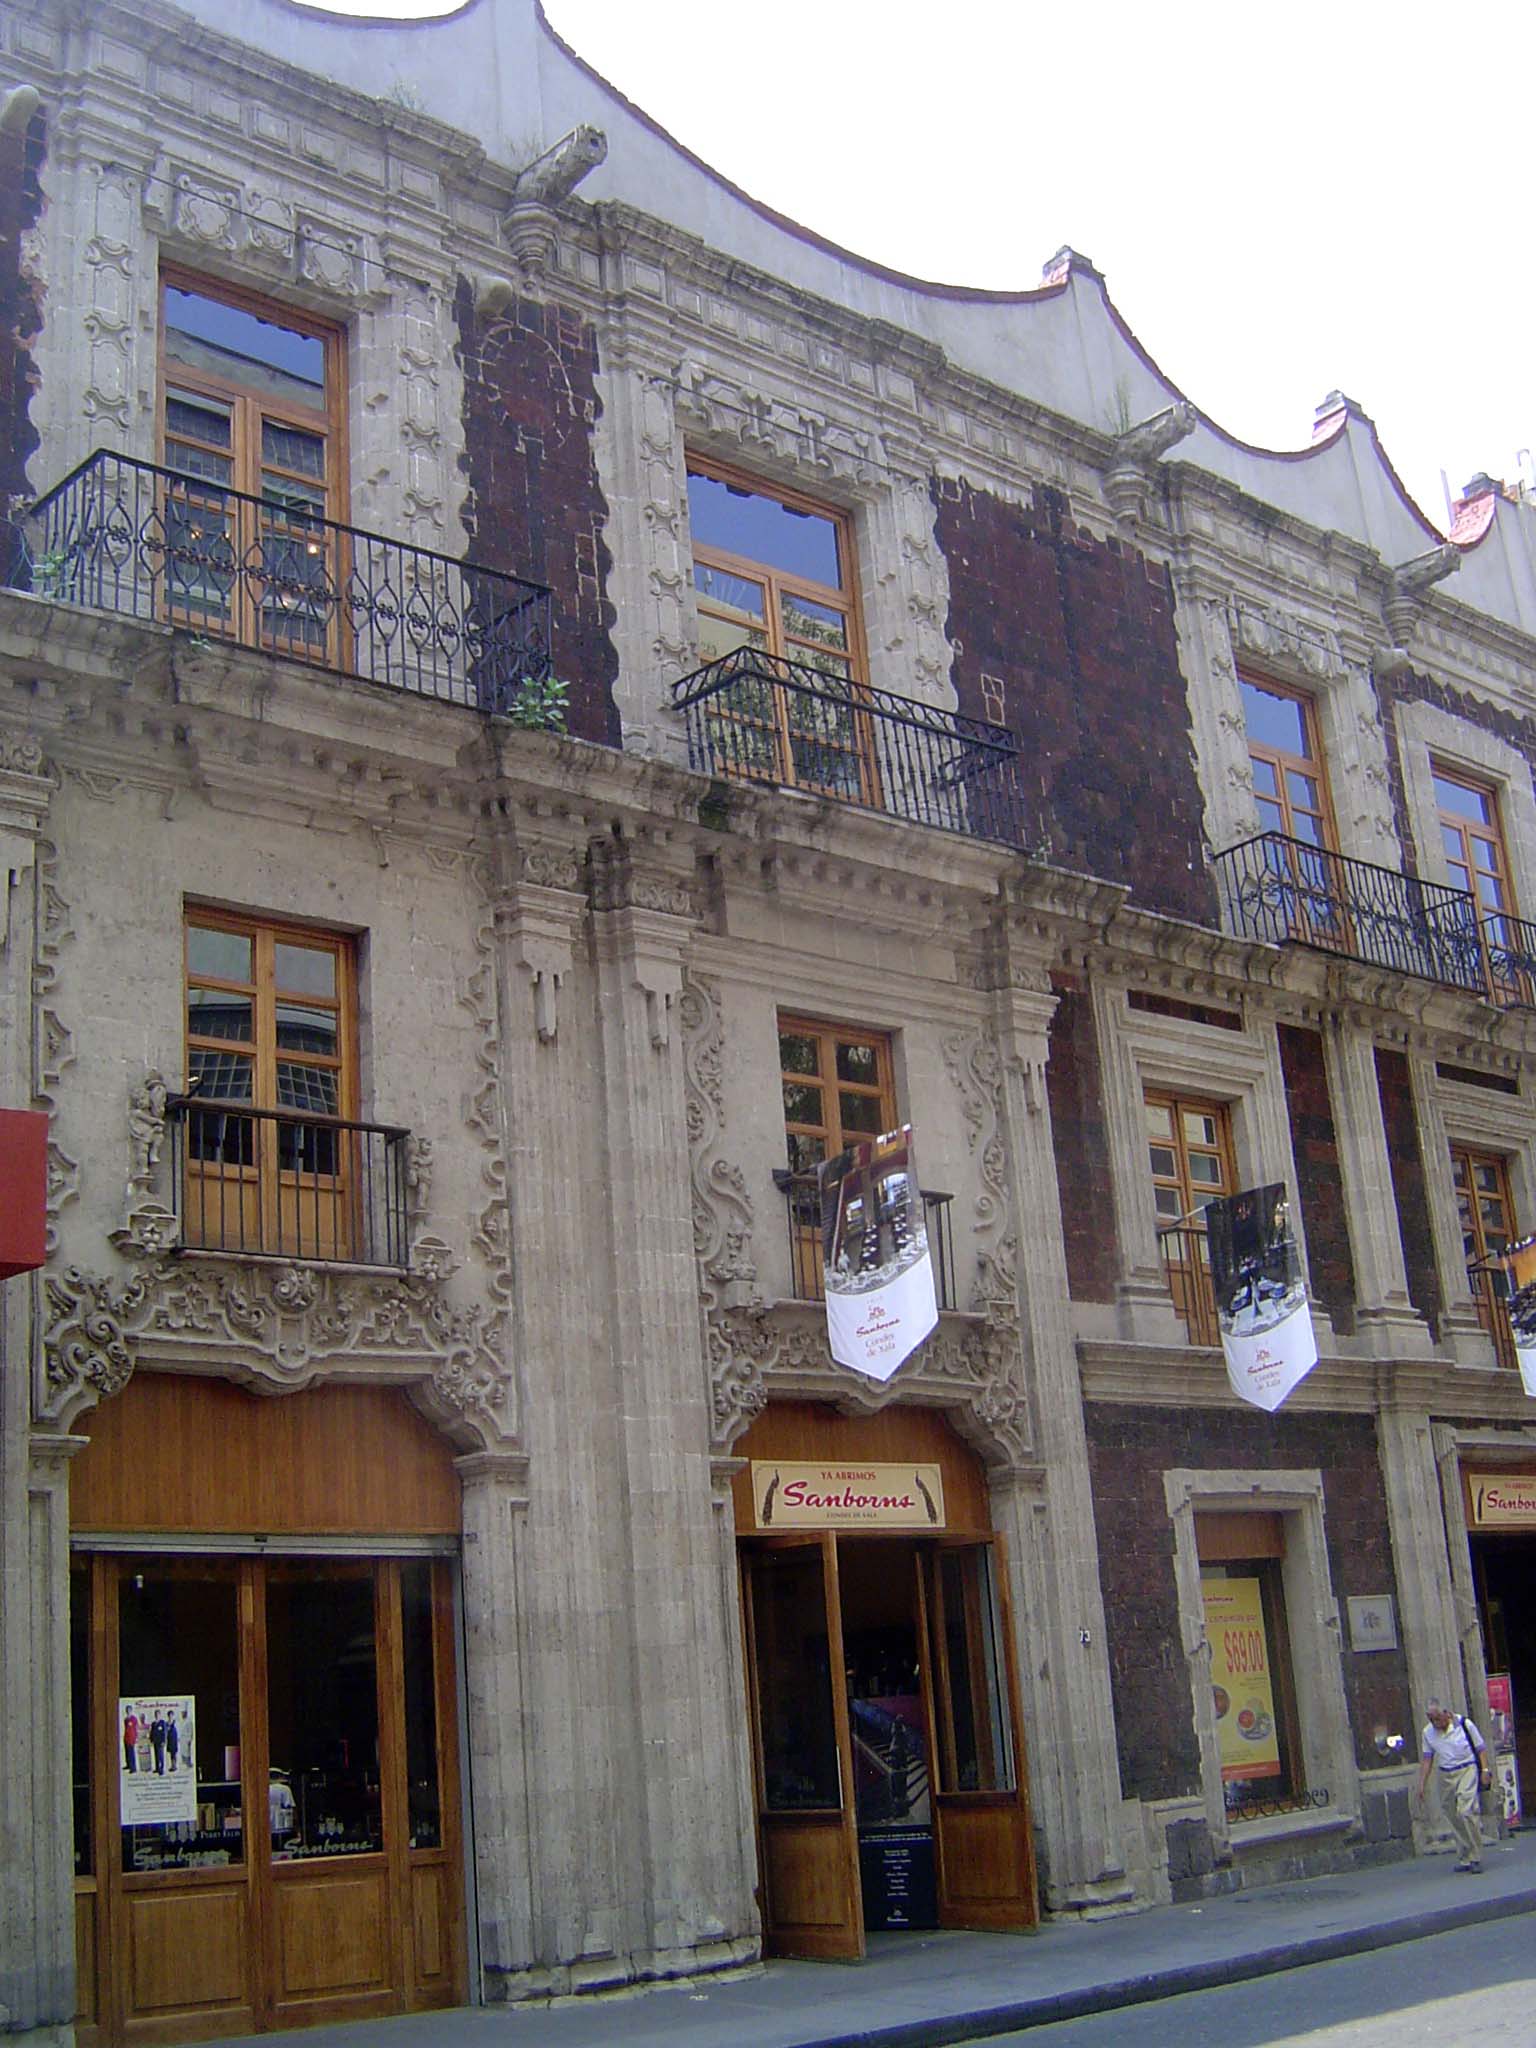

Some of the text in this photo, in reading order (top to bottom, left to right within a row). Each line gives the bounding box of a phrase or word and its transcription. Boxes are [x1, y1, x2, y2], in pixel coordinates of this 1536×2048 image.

[856, 1318, 900, 1337] Sanborns
[821, 1472, 877, 1480] YA ABRIMOS
[783, 1481, 916, 1509] Sanborns
[283, 1837, 374, 1855] Sanborns
